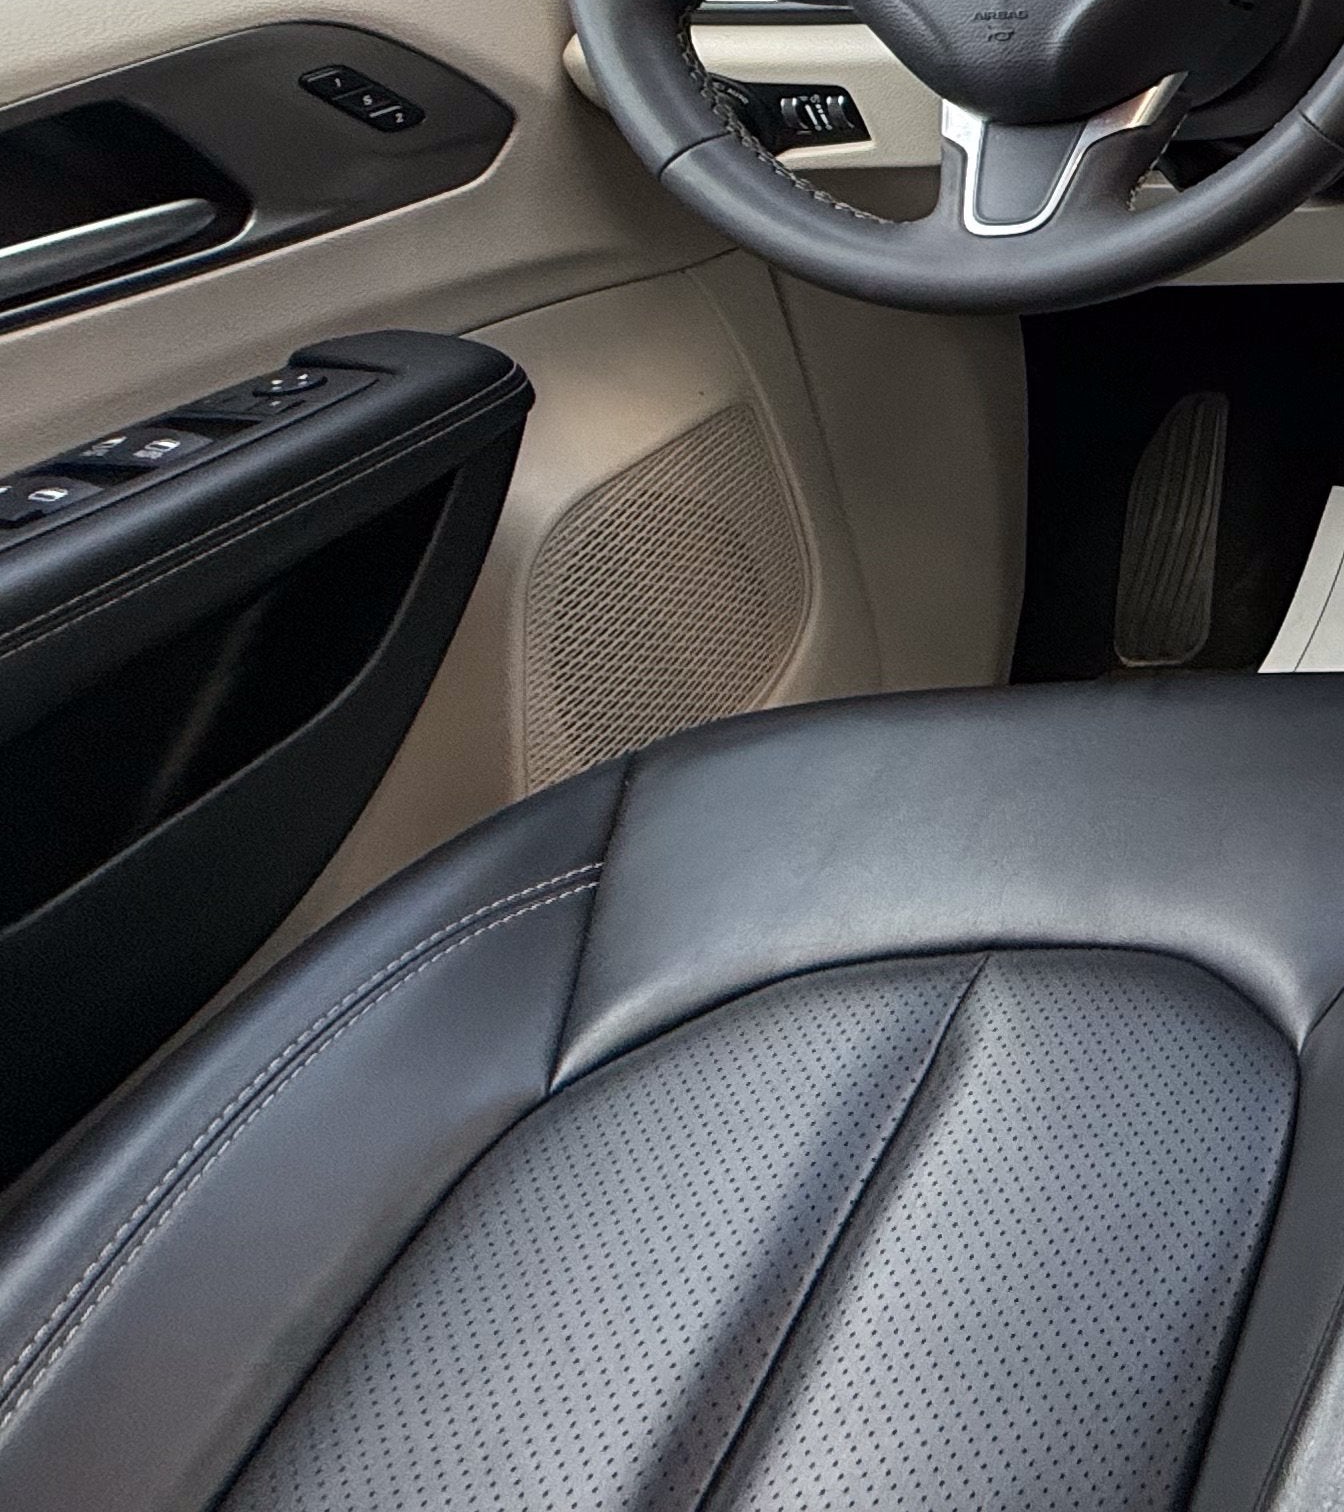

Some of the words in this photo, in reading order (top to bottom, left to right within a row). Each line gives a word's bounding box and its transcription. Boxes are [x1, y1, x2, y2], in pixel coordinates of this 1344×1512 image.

[973, 10, 1029, 21] AIRBAG
[334, 78, 341, 88] 1
[362, 94, 373, 105] S
[395, 112, 404, 123] 2
